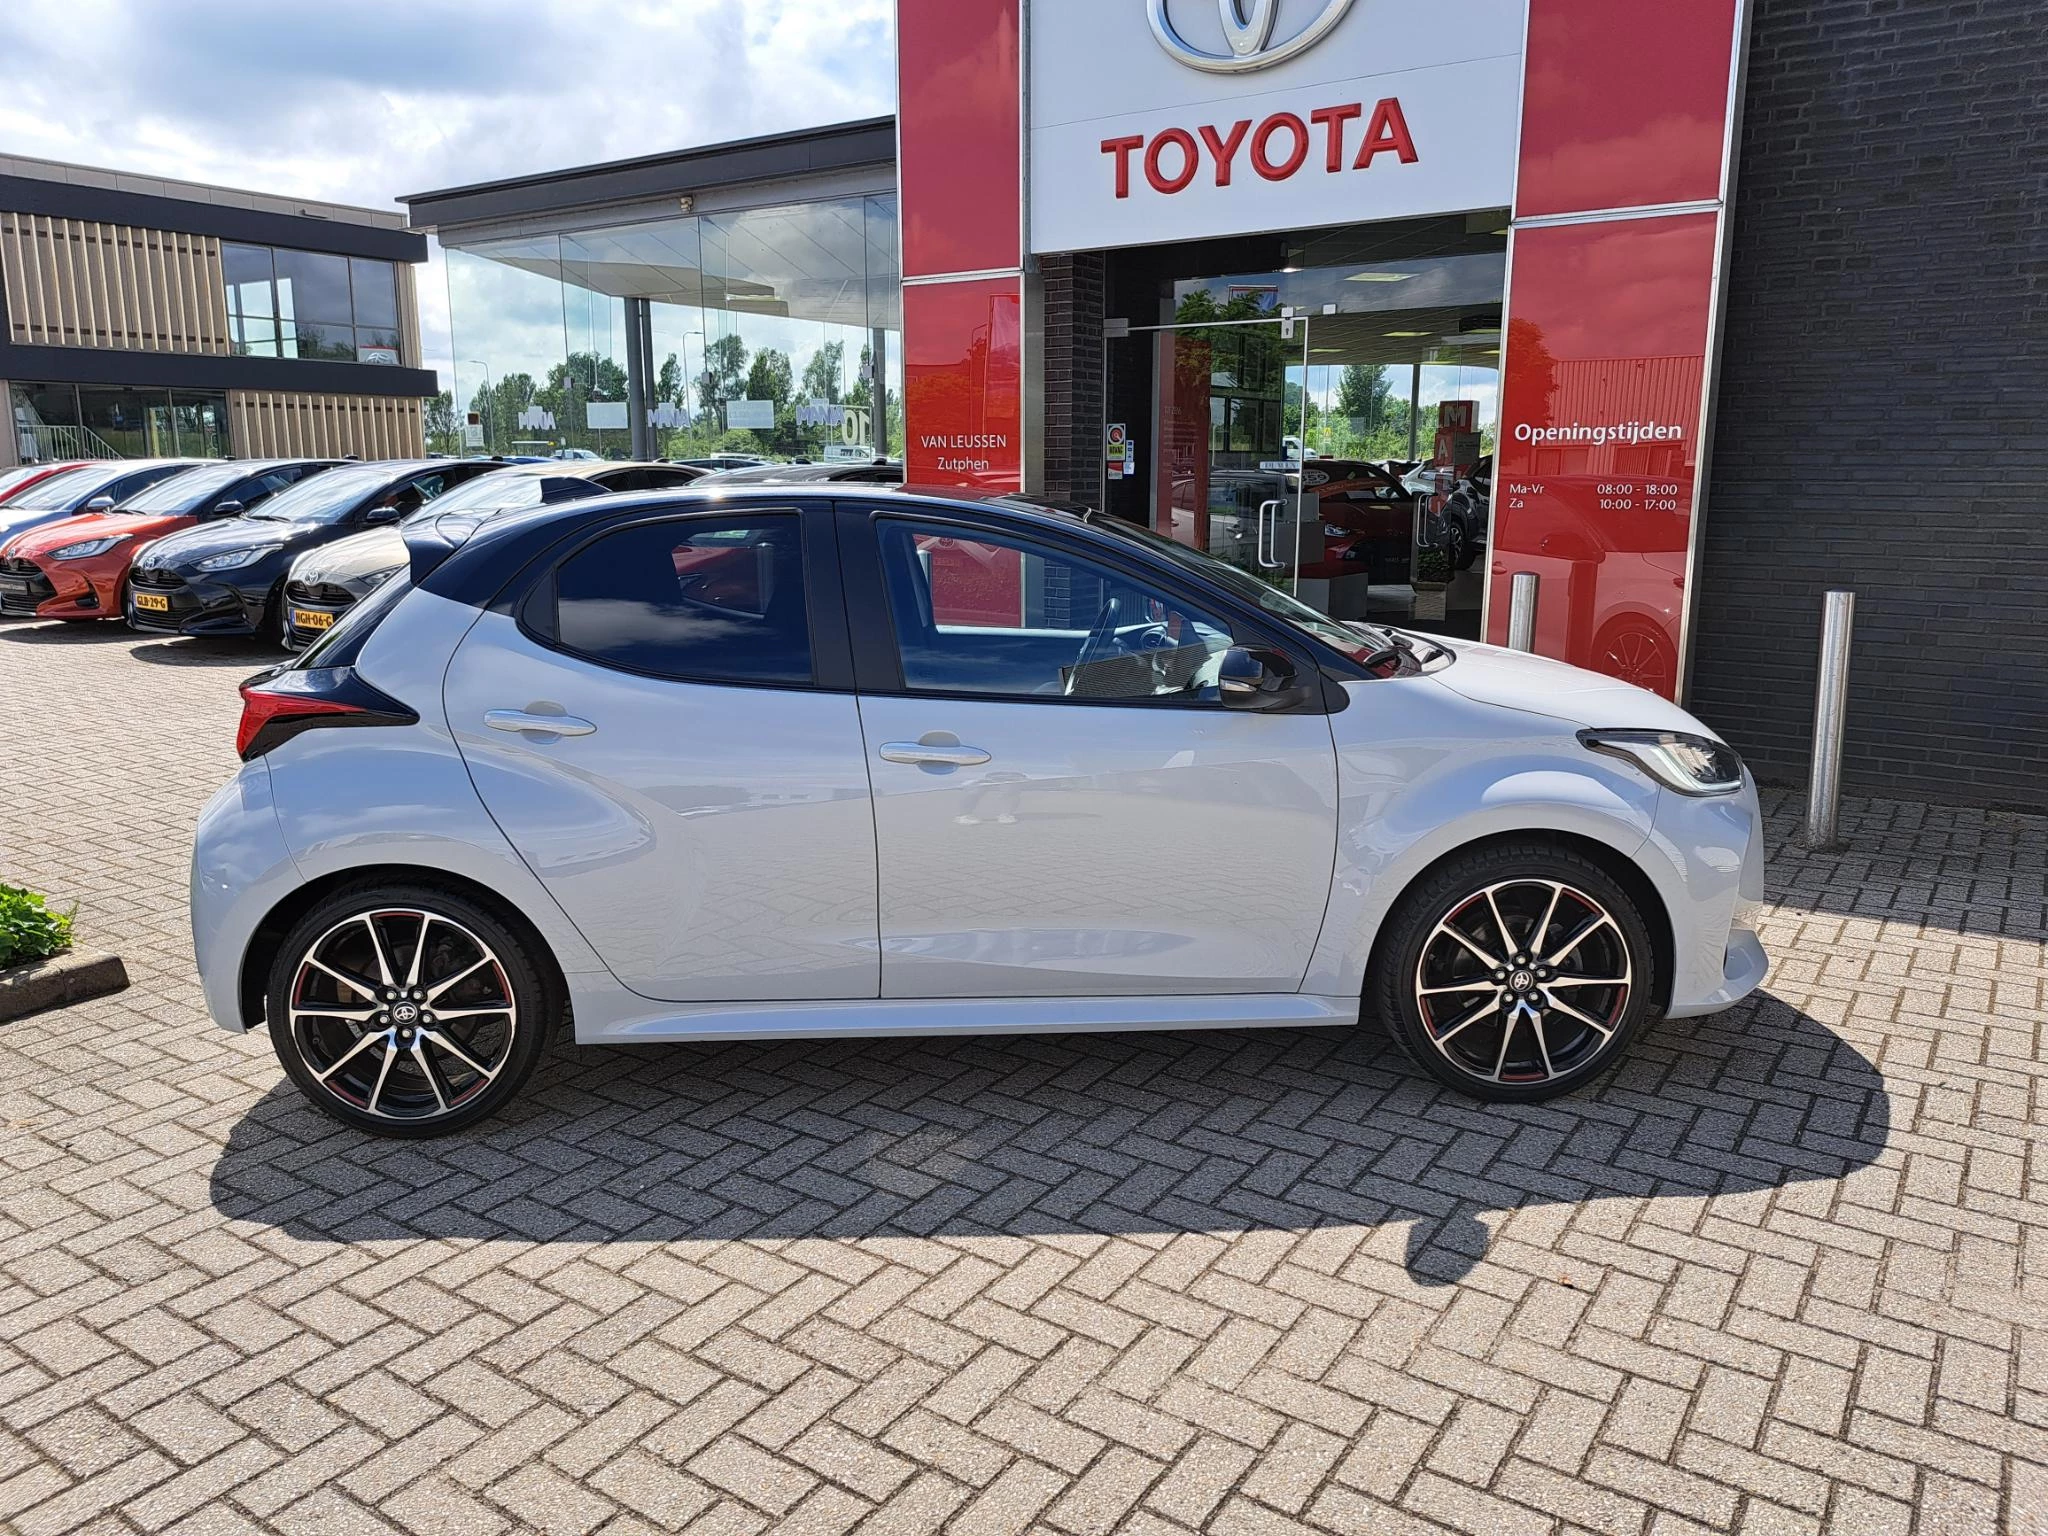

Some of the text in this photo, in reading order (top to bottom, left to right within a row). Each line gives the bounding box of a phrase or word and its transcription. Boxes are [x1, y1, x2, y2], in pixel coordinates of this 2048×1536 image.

[1101, 97, 1419, 199] TOYOTA
[1444, 405, 1466, 428] M
[921, 434, 1007, 448] VAN LEUSSEN
[1514, 421, 1682, 446] Openingstijden
[937, 456, 989, 472] Zutphen
[1509, 483, 1545, 495] Ma-Vr
[1597, 484, 1633, 495] 08:00
[1644, 484, 1678, 495] 18:00
[1509, 497, 1524, 509] Za
[1599, 499, 1632, 510] 10:00
[1644, 499, 1677, 511] 17:00
[137, 595, 166, 609] GLB-29-G
